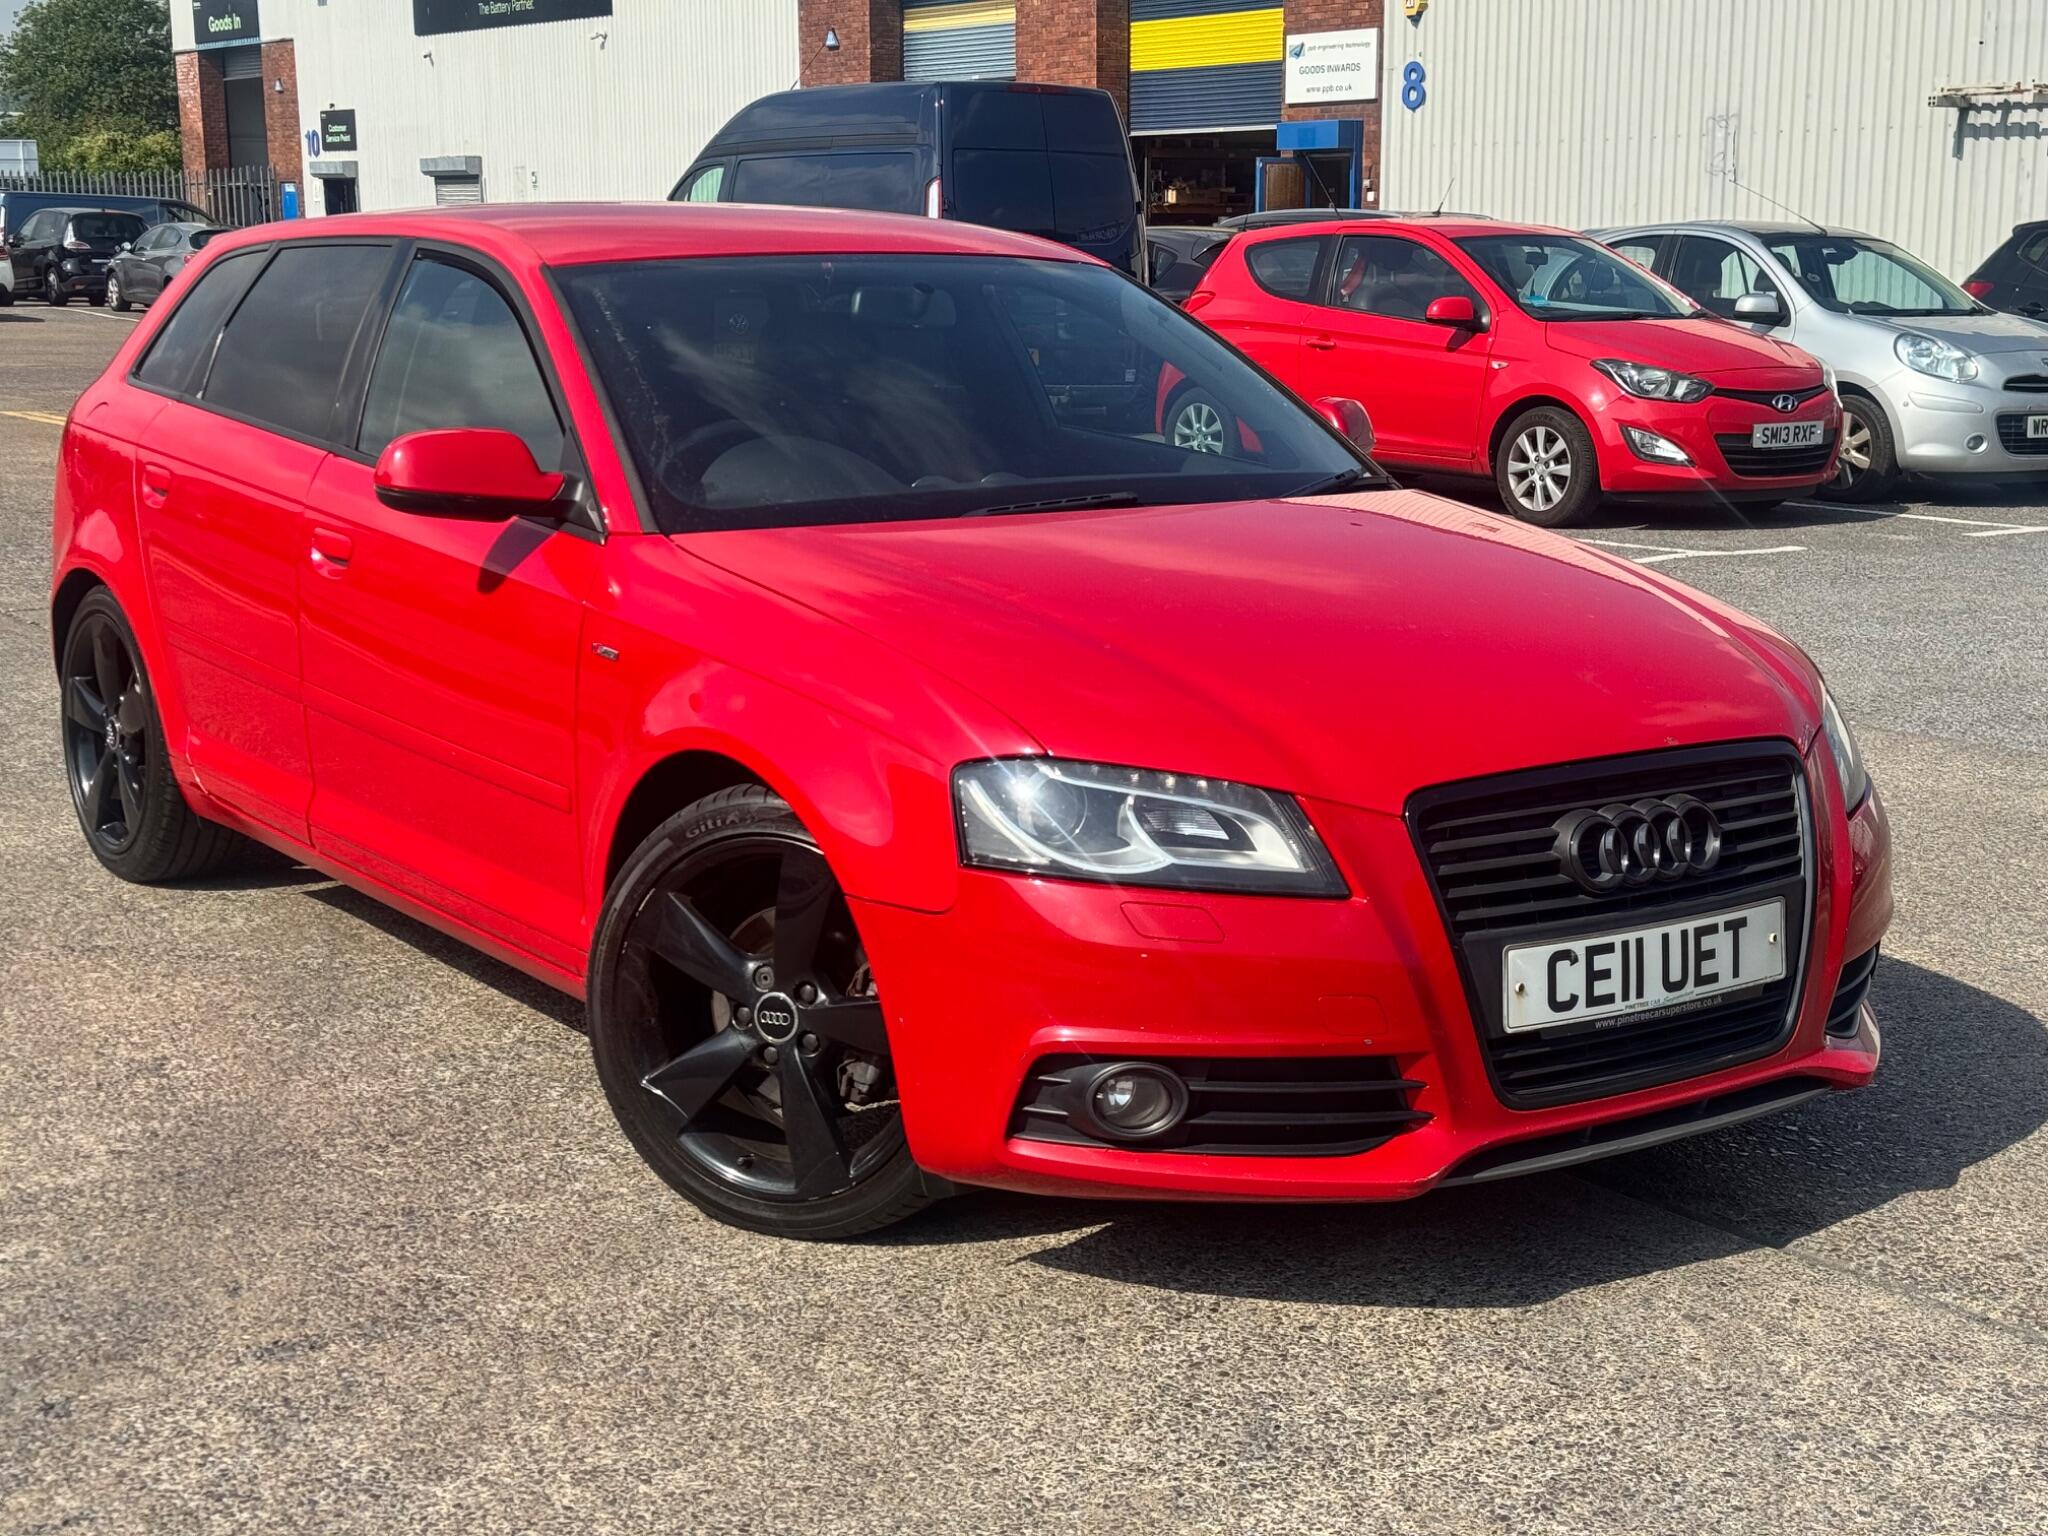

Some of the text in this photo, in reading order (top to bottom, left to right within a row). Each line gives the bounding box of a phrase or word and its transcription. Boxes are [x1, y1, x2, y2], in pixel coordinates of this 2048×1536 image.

[478, 3, 489, 15] The
[490, 1, 511, 15] Battery
[208, 13, 242, 32] Goods In
[1299, 62, 1361, 75] GOODS INWARDS
[1402, 61, 1425, 110] 8
[305, 129, 320, 157] 10
[1762, 424, 1817, 445] SM13 RXF
[1547, 916, 1748, 1014] CE11 UET
[1594, 995, 1723, 1030] www.pinetreecarsuperstore.co.uk
